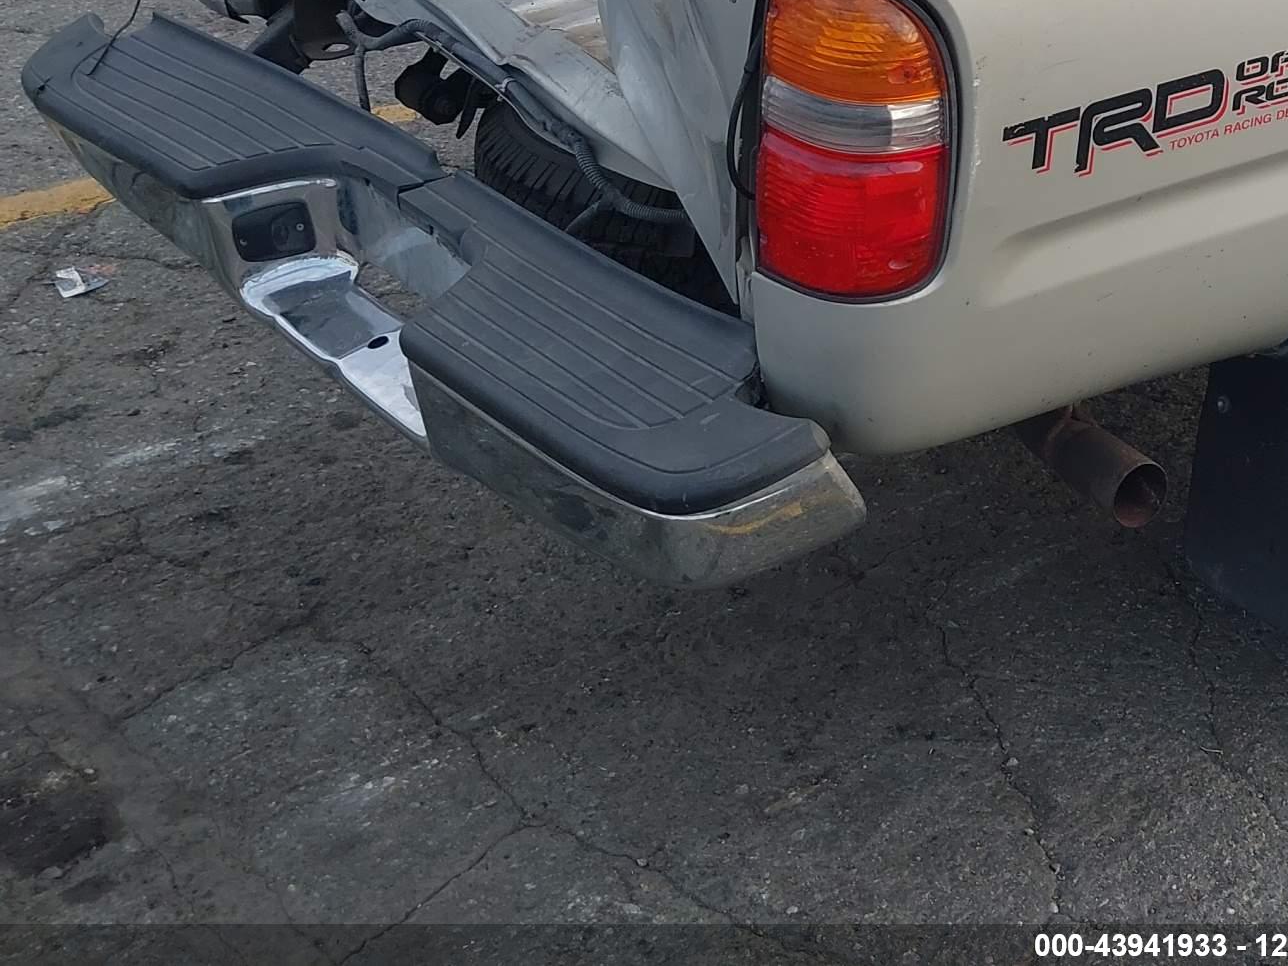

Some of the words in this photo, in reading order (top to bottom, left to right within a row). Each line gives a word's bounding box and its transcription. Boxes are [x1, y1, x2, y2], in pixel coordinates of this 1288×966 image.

[1002, 68, 1234, 177] TRD
[1170, 129, 1220, 151] TOYOTA
[1223, 116, 1273, 136] RACING
